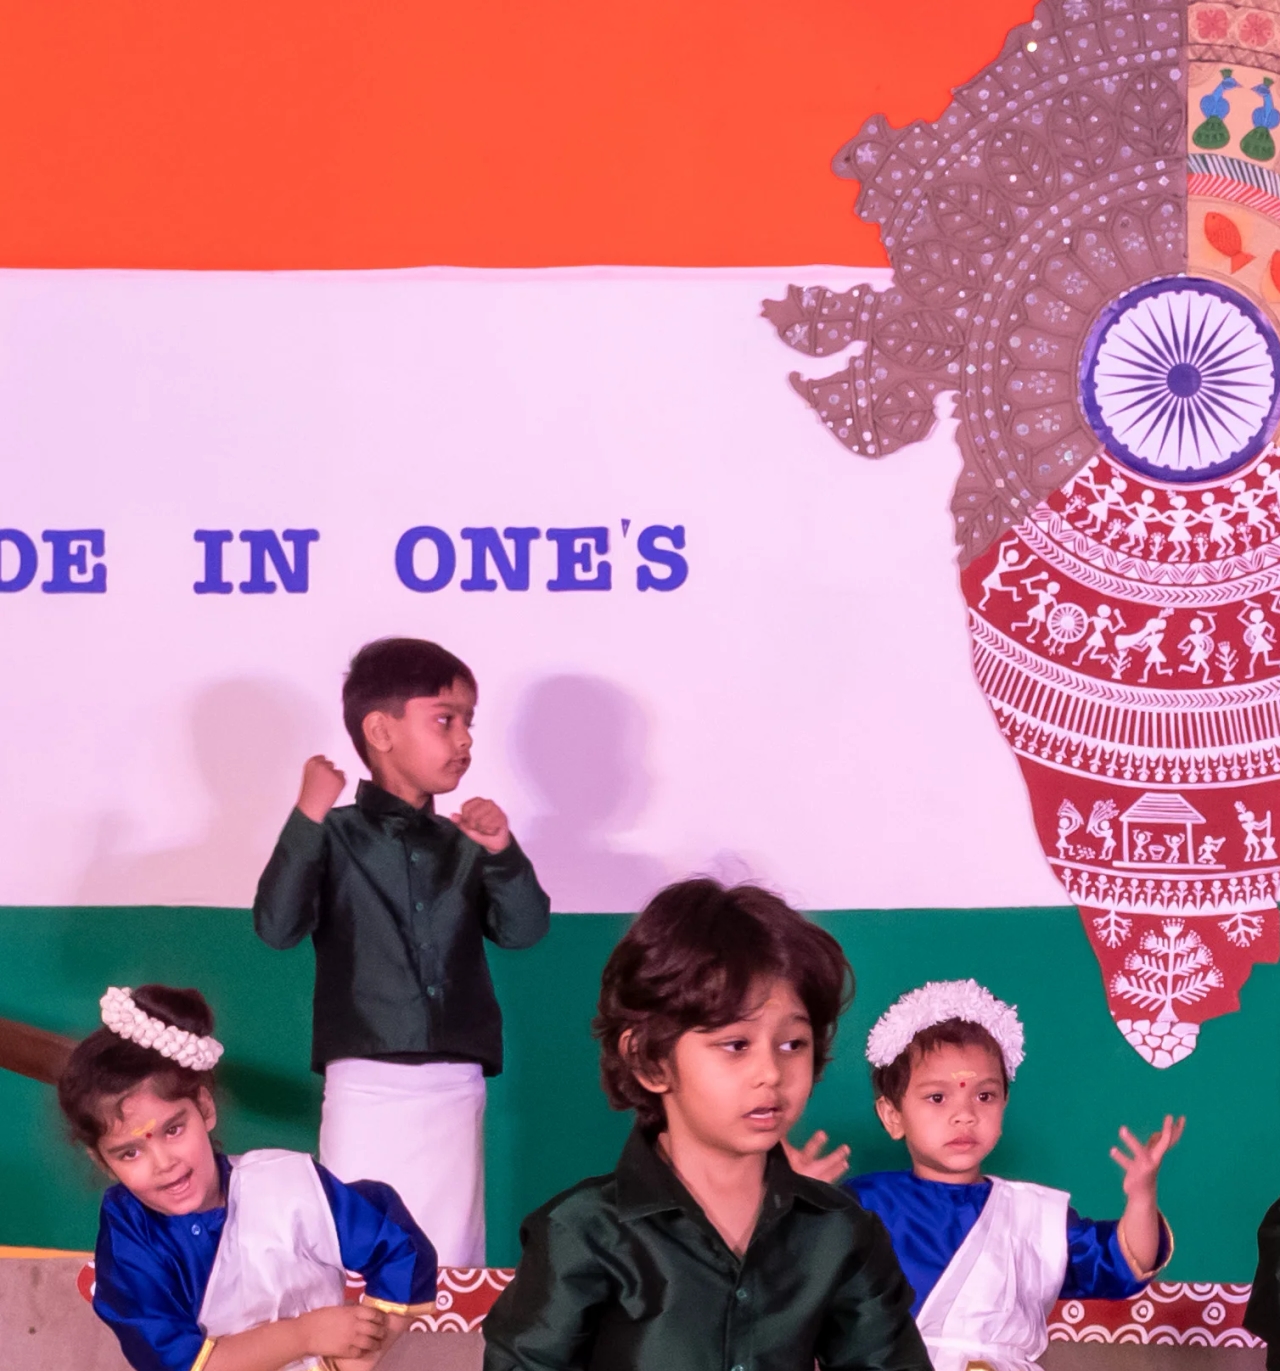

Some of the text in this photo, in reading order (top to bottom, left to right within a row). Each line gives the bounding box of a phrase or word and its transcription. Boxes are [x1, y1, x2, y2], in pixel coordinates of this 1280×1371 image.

[0, 528, 107, 593] DE
[193, 528, 320, 594] IN
[395, 519, 689, 593] ONE'S
